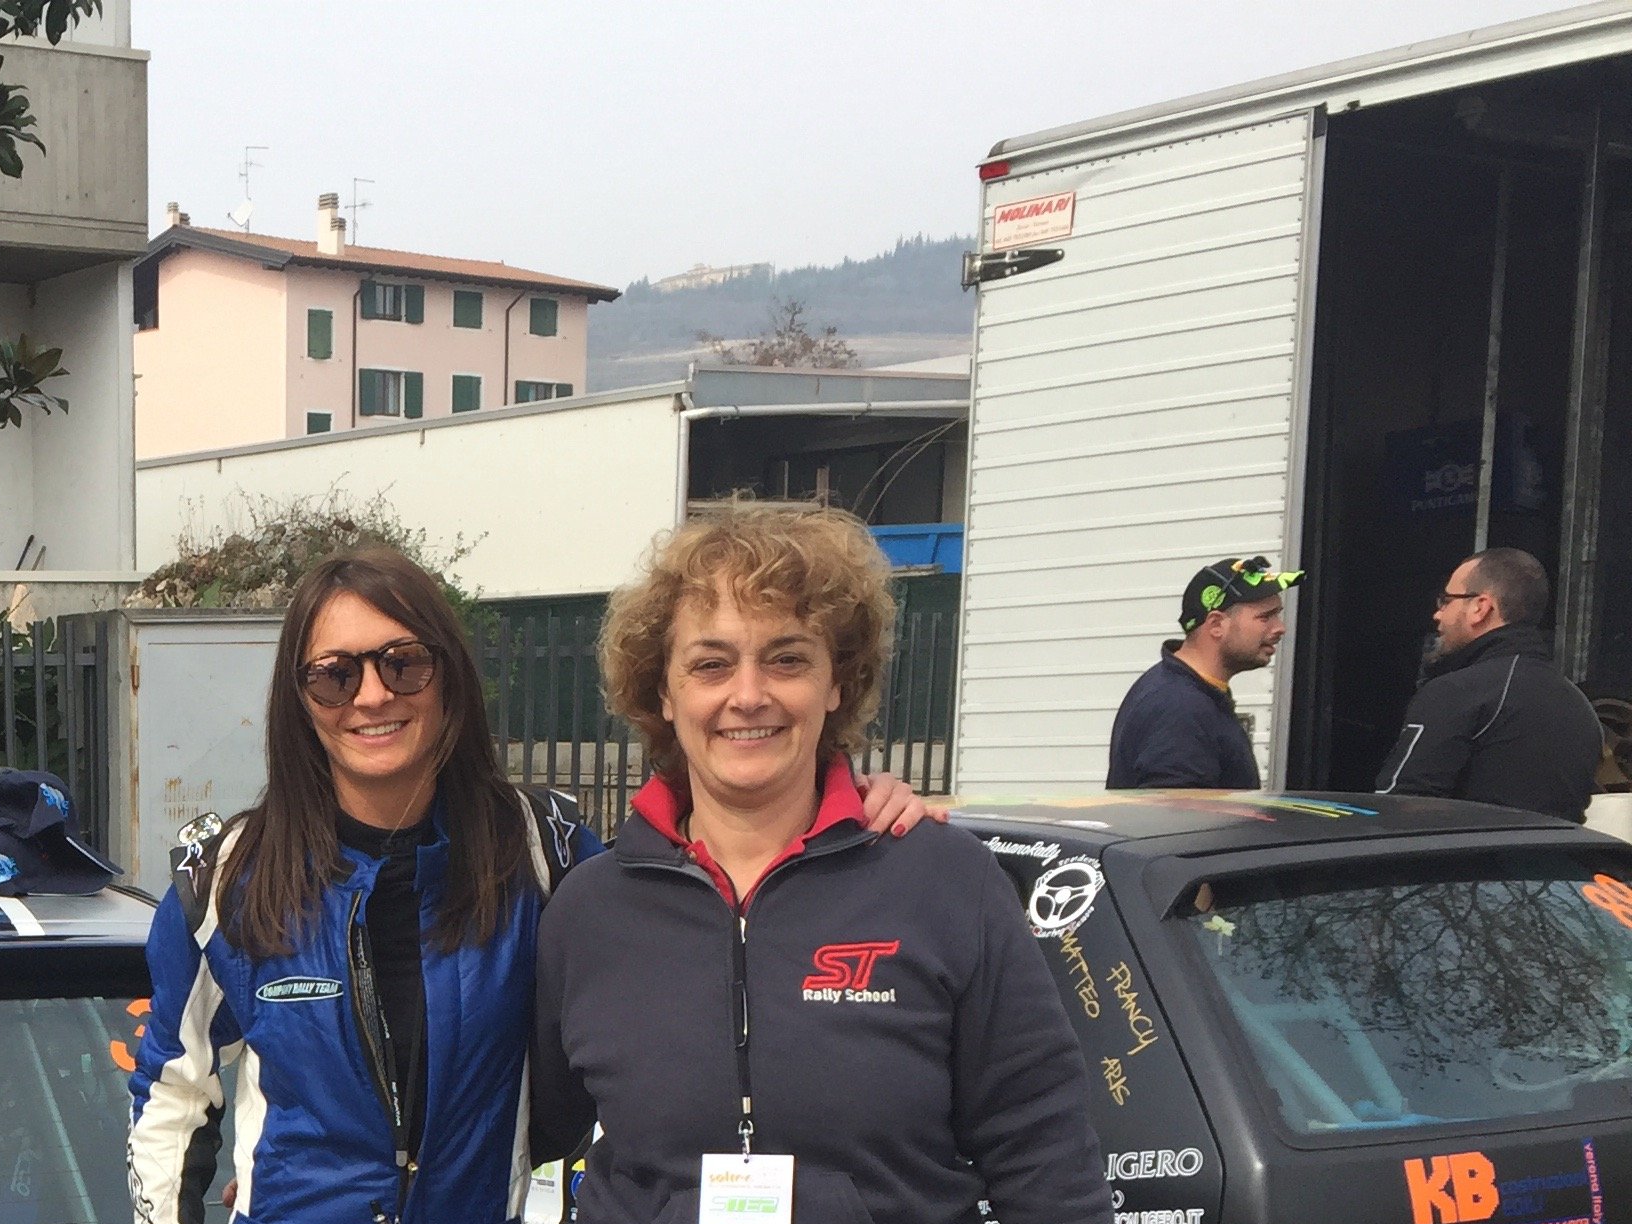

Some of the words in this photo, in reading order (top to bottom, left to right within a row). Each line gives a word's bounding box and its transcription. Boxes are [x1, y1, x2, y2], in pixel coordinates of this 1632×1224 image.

[997, 196, 1071, 224] MOLINARI
[802, 938, 902, 990] ST
[315, 982, 339, 994] TEAM
[803, 987, 842, 1004] Rally
[845, 987, 897, 1003] School
[1104, 1147, 1204, 1182] IGERO
